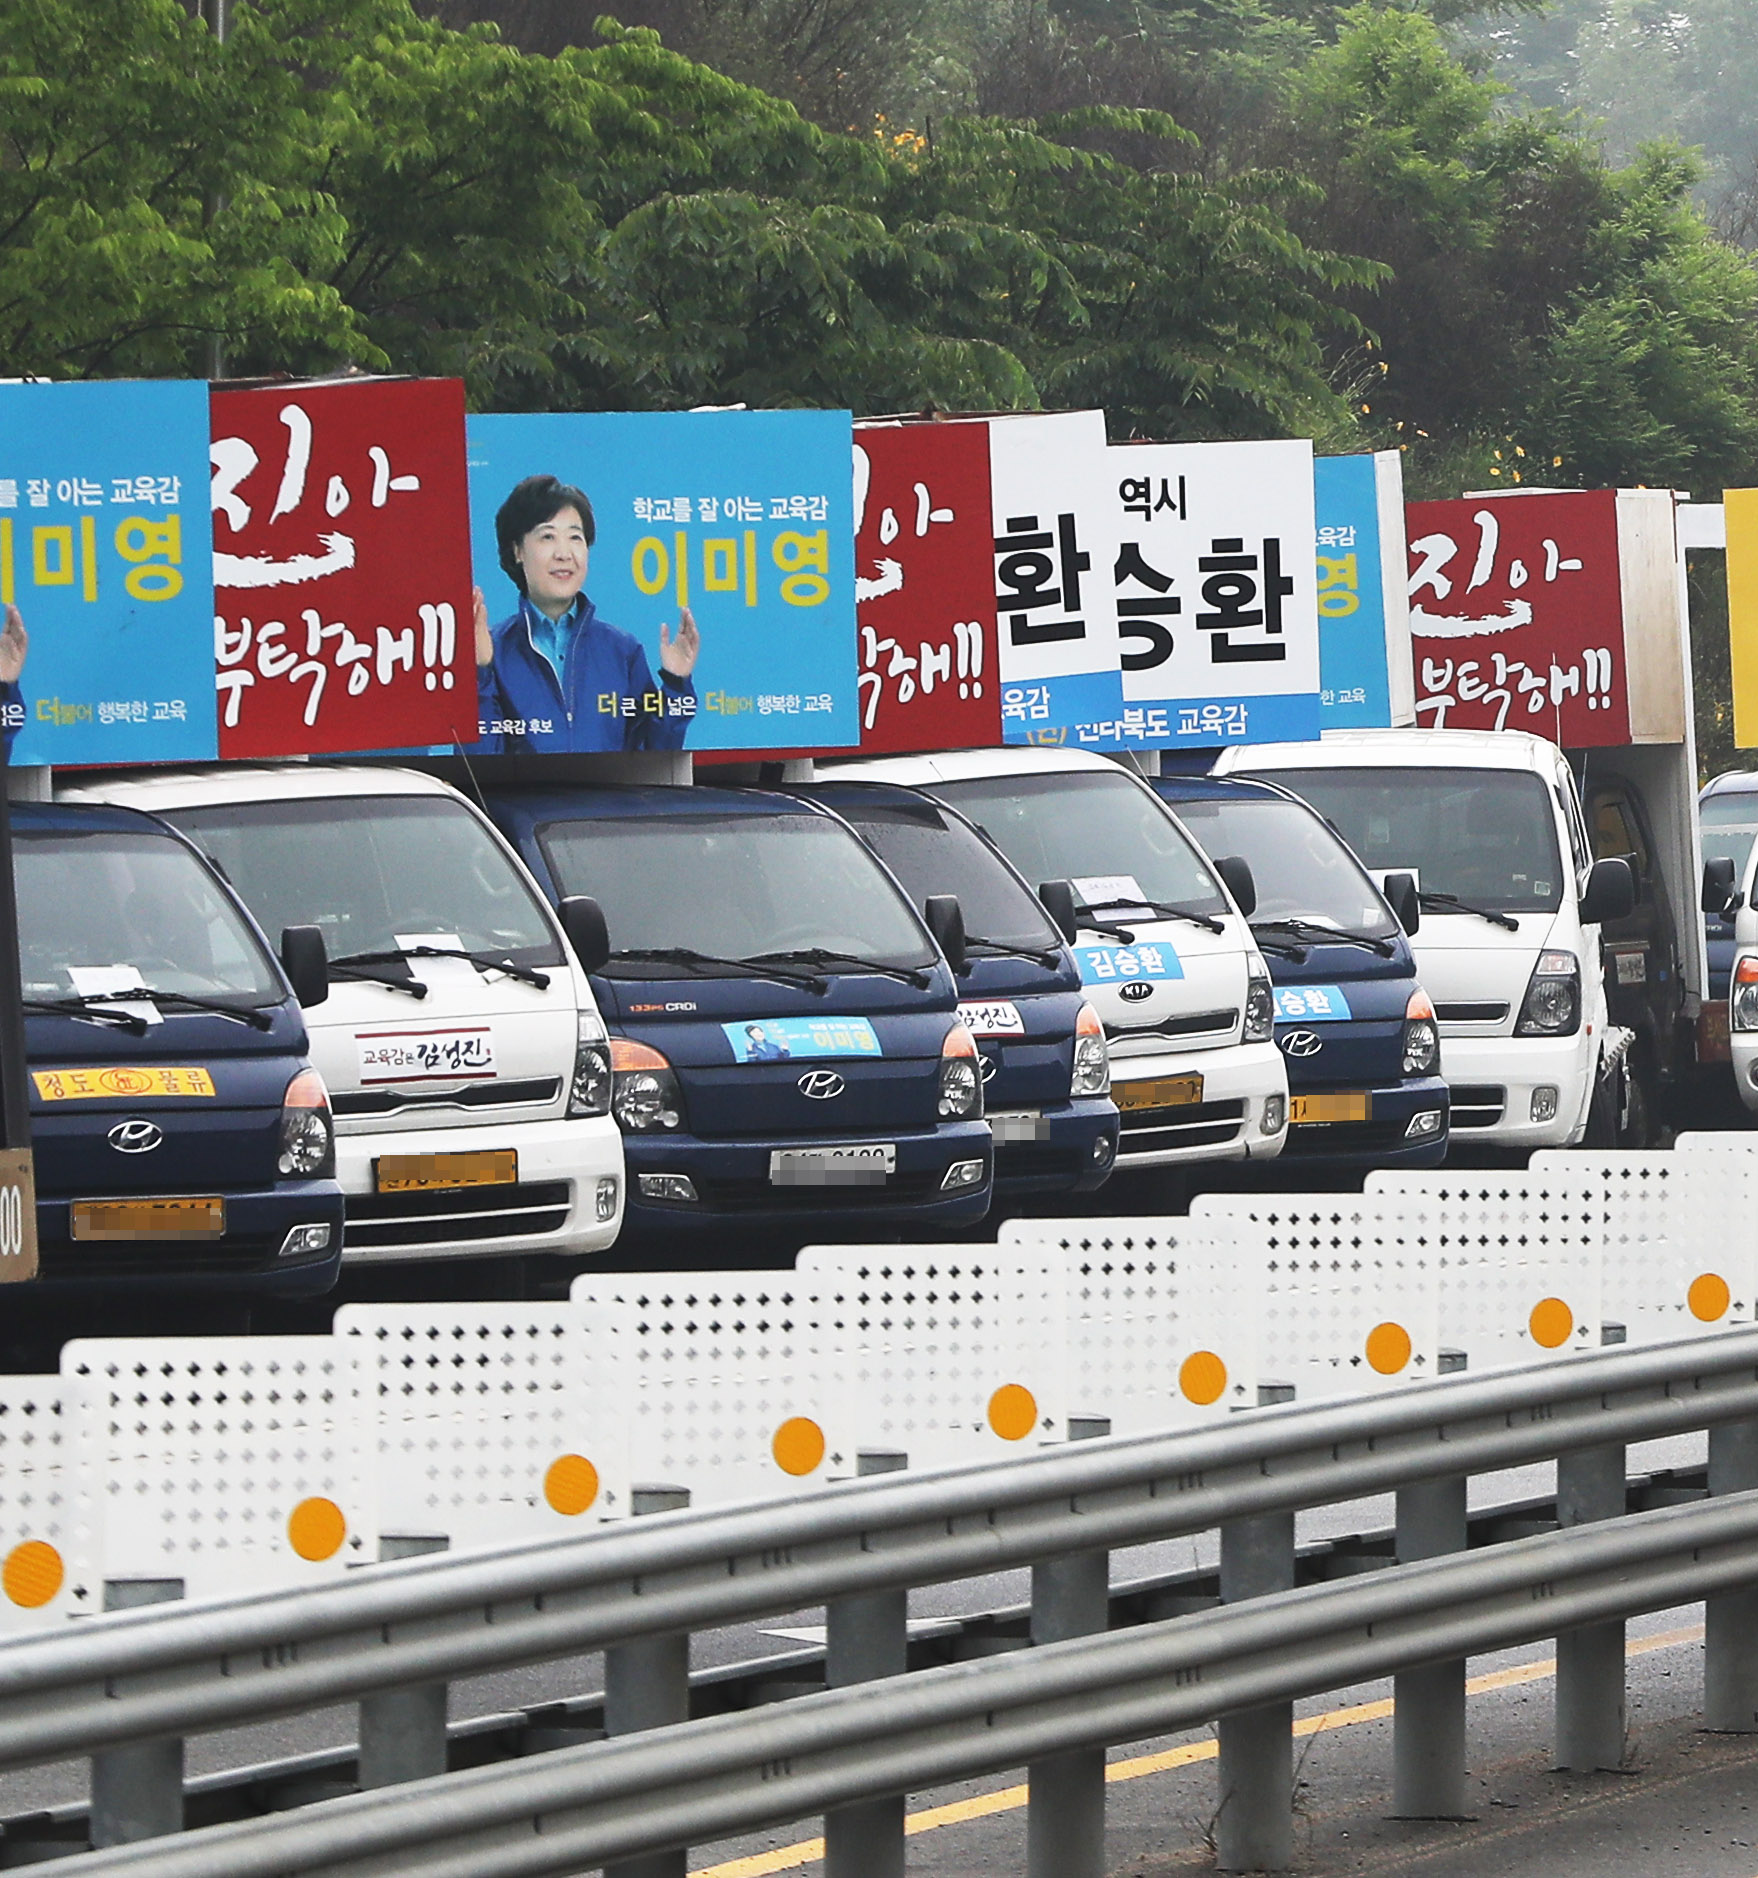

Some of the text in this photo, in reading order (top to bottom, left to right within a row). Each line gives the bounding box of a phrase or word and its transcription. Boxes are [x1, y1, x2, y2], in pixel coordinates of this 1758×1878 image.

[26, 477, 51, 507] 잘
[57, 477, 104, 507] 아는
[110, 475, 182, 505] 교육감
[1118, 475, 1187, 522] 역시
[633, 494, 829, 523] 학교를 잘 아는 교육감
[1315, 526, 1357, 548] 육감
[0, 513, 183, 602] 미영
[631, 529, 831, 607] 이미영
[1409, 509, 1584, 638] 진아
[597, 691, 618, 717] 더
[620, 697, 637, 717] 큰
[643, 690, 664, 717] 더
[667, 694, 697, 717] 넓은
[757, 694, 801, 714] 행복한
[803, 693, 834, 713] 교육
[1001, 686, 1051, 720] 육감
[1338, 688, 1366, 704] 교육
[1416, 648, 1612, 731] 부탁해!!
[98, 701, 148, 725] 행복한
[152, 699, 187, 723] 교육
[490, 720, 526, 735] 교육감
[528, 719, 554, 735] 후보
[1177, 704, 1249, 736] 교육감
[1086, 946, 1166, 979] 김승환
[1125, 984, 1149, 997] KIA
[363, 1048, 414, 1067] 교육감은
